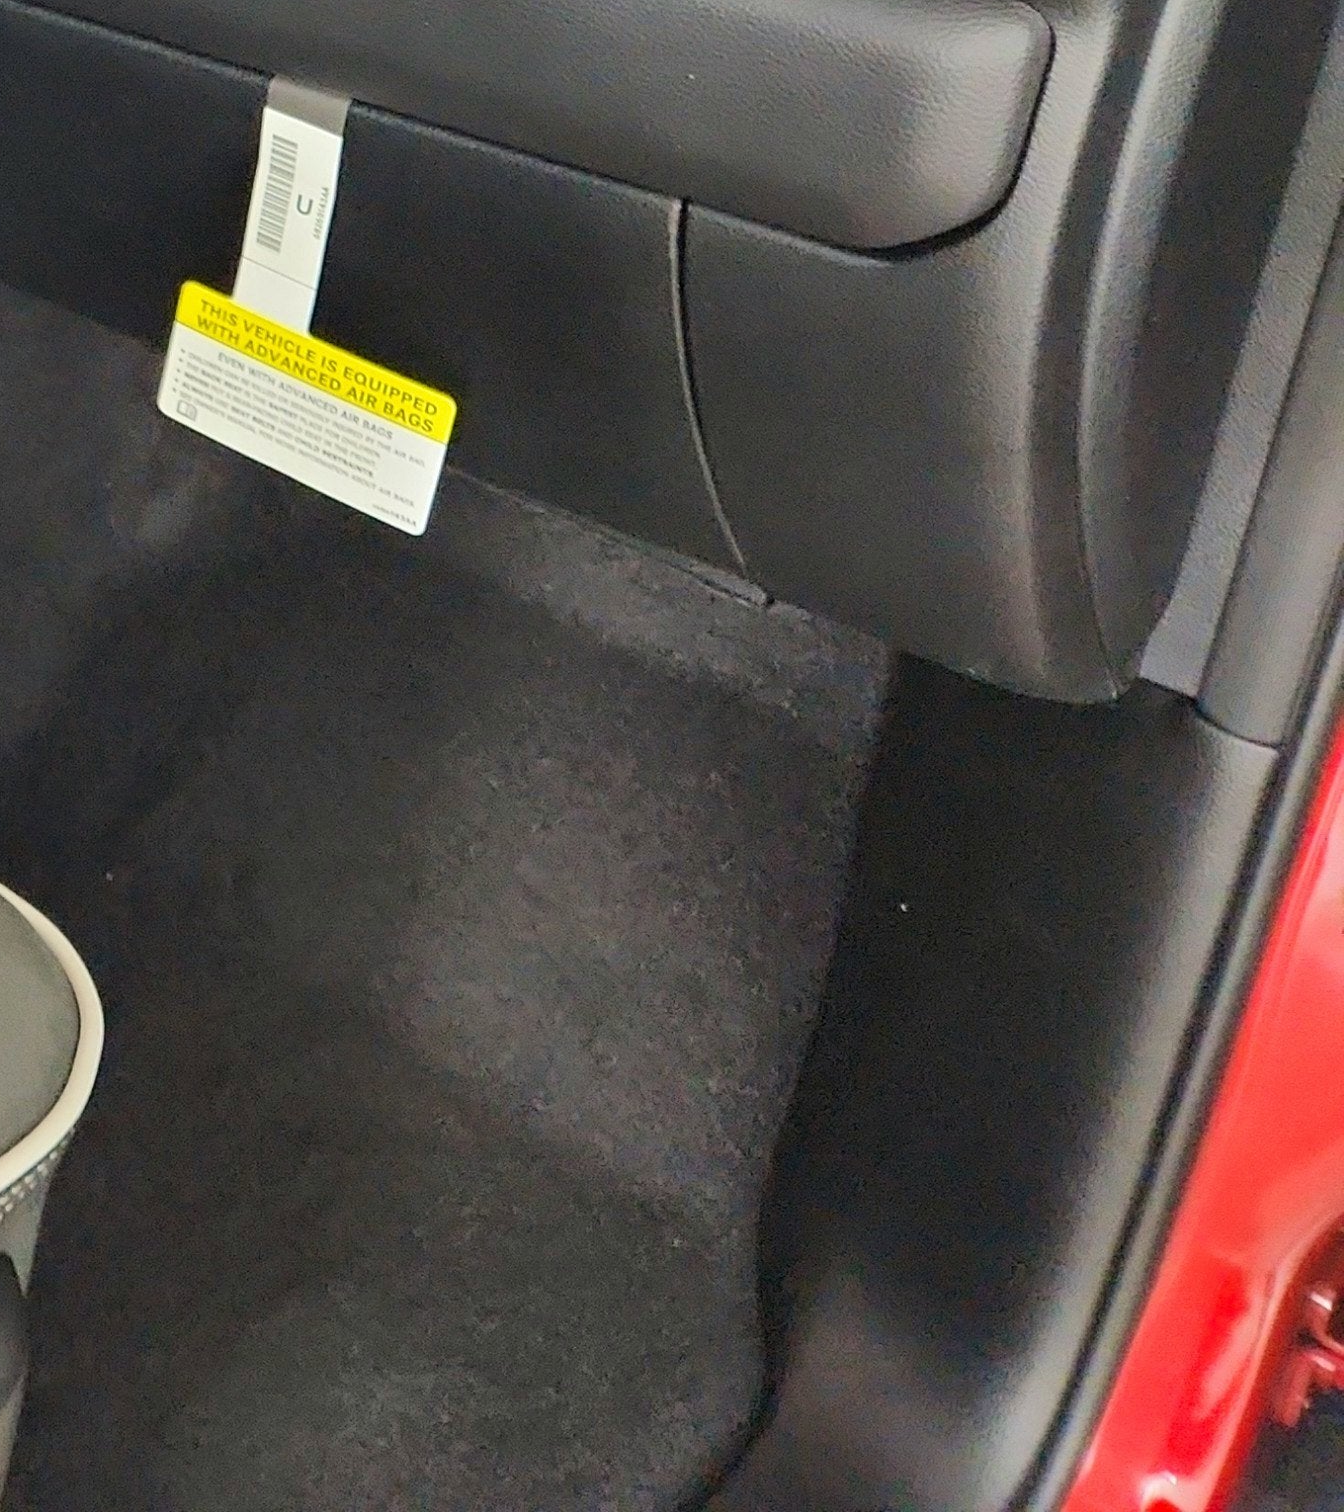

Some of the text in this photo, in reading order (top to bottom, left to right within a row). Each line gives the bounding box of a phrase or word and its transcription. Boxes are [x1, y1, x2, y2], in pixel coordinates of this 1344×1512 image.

[296, 193, 314, 216] U
[195, 314, 240, 345] WITH
[243, 337, 342, 392] ADVANCED
[345, 384, 377, 409] AIR
[382, 400, 434, 434] BAGS
[198, 298, 239, 327] THIS
[240, 319, 317, 364] VEHICLE
[319, 355, 338, 373] IS
[342, 365, 439, 418] EQUIPPED
[217, 350, 246, 372] EVEN
[246, 365, 276, 386] WITH
[277, 380, 339, 416] ADVANCED
[340, 409, 360, 425] AIR
[361, 419, 393, 440] BAGS
